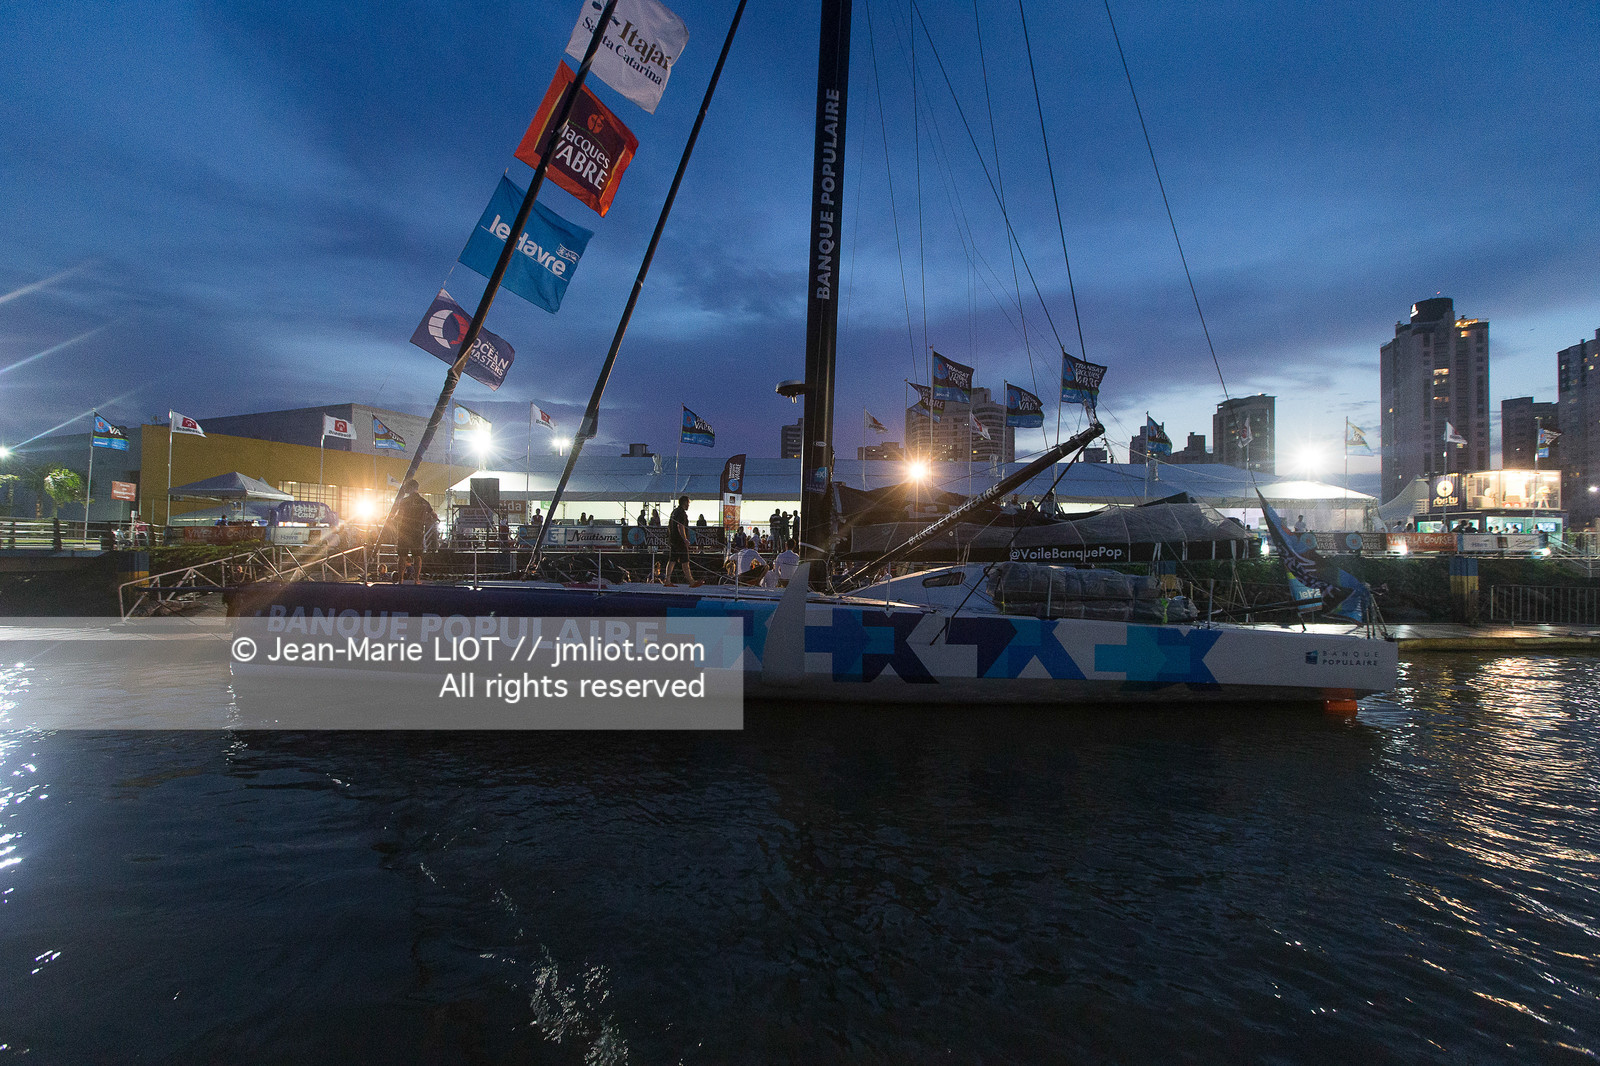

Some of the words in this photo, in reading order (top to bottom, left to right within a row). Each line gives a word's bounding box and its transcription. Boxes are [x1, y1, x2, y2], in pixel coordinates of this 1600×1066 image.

[582, 16, 614, 50] Sata
[616, 44, 662, 85] Catarina
[618, 19, 672, 71] Itajaí
[560, 125, 610, 169] Jacques
[821, 88, 839, 205] POPULAIRE
[816, 210, 834, 300] BANQUE
[1075, 363, 1104, 374] TRANSAT
[567, 529, 620, 543] Nautisme
[644, 537, 670, 546] VABRE
[1424, 535, 1452, 544] COURSE
[1010, 546, 1122, 561] @VoileBanquePop
[267, 603, 410, 641] BANQUE
[421, 611, 659, 654] POPULAIRE
[1325, 651, 1388, 660] BANQUE
[1325, 661, 1387, 669] POPULAIRE
